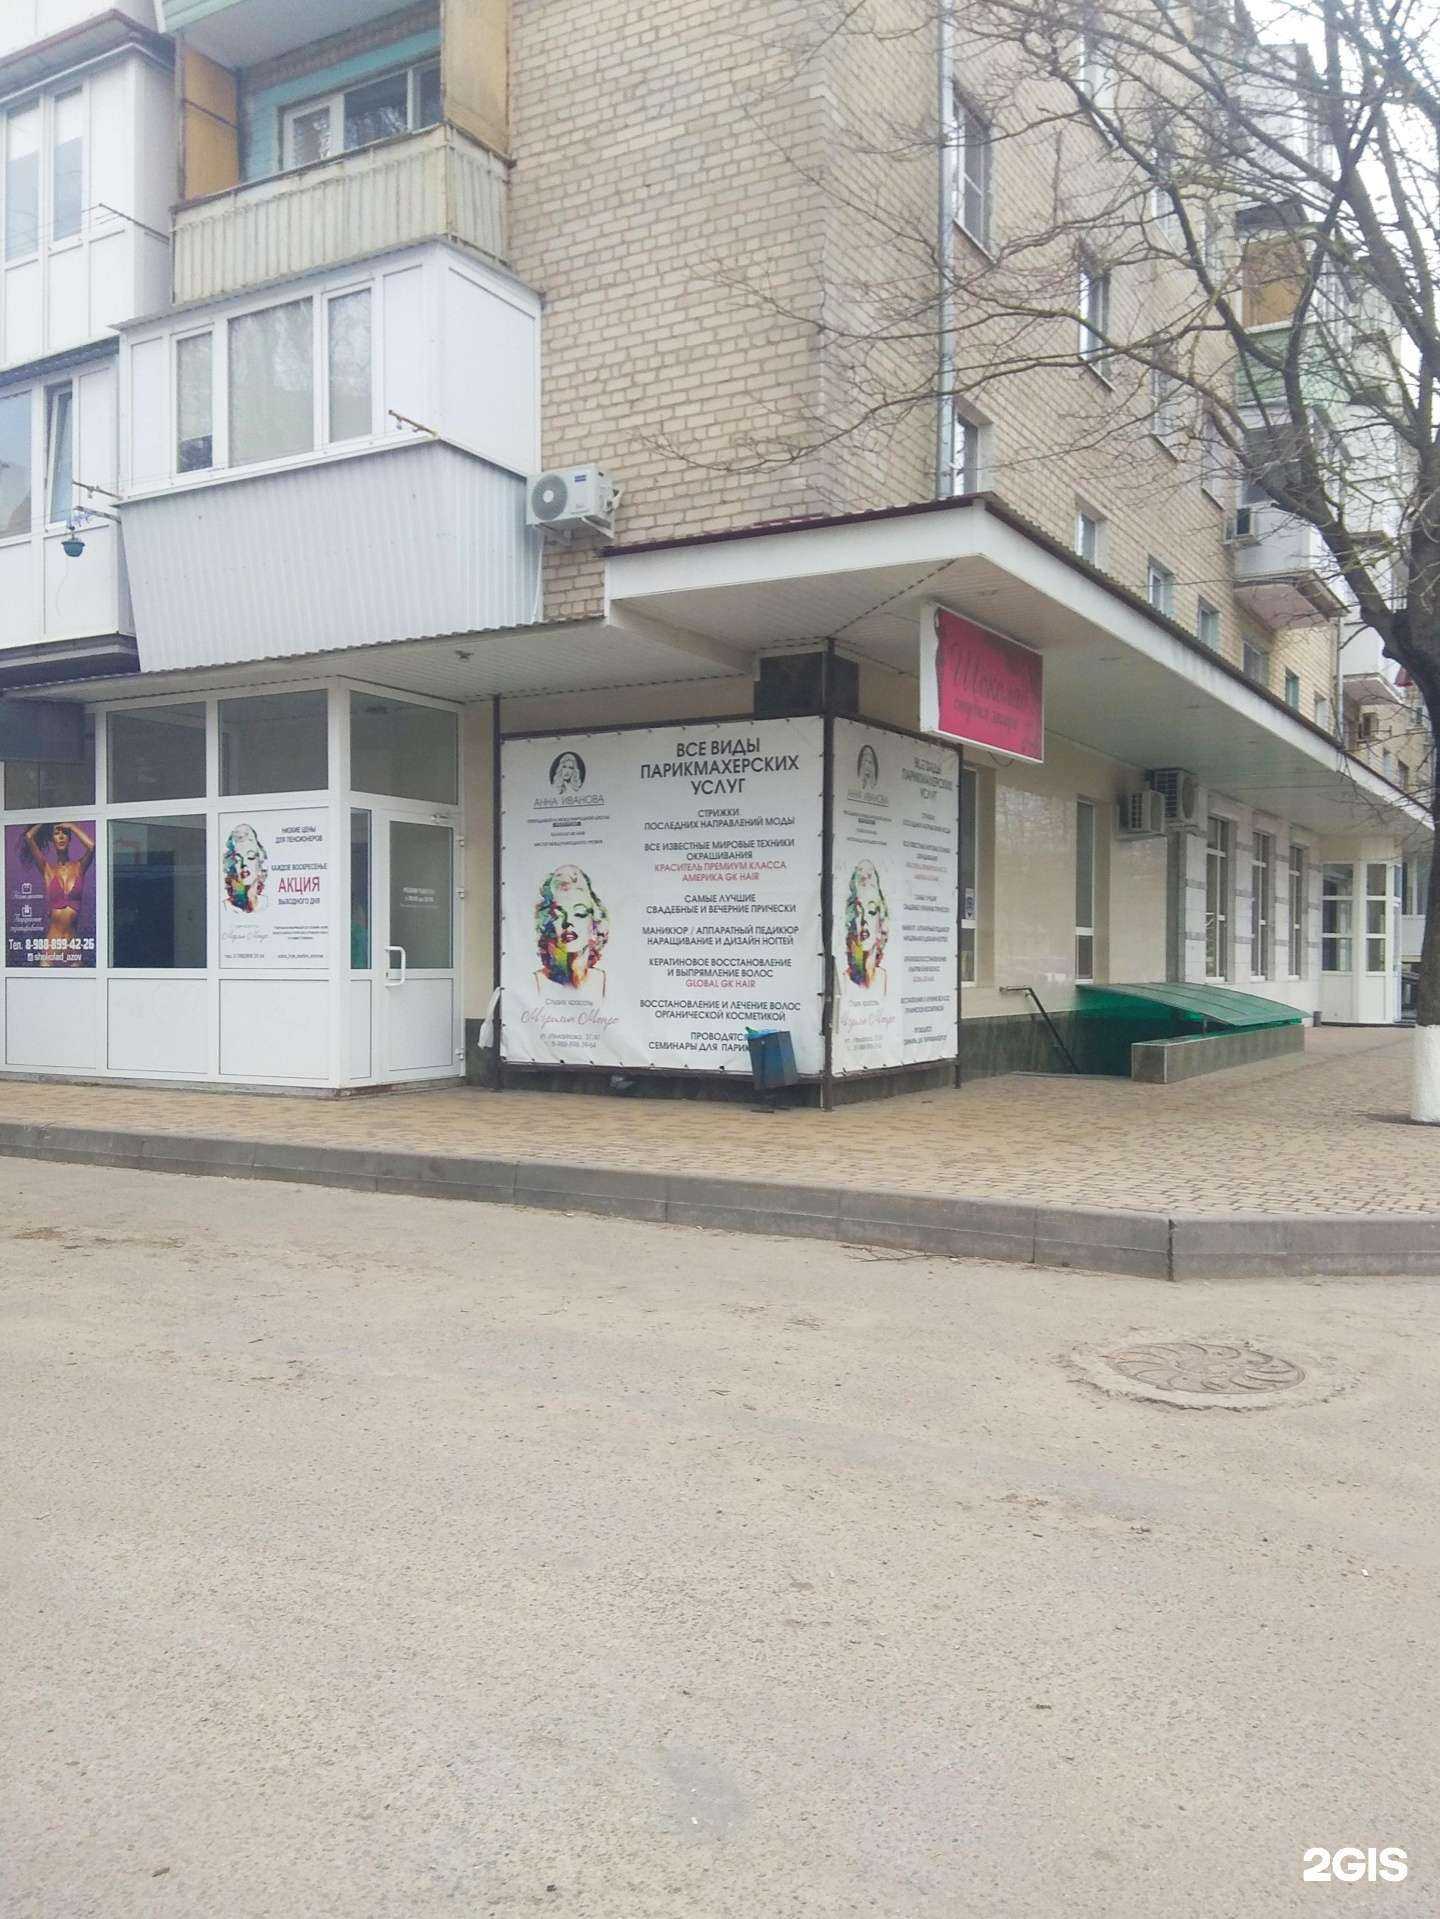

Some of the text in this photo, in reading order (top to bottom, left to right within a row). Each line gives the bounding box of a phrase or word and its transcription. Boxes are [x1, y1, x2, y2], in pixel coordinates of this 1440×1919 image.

[676, 737, 760, 757] ВСЕ ВИДЫ
[641, 755, 799, 779] ПАРИКМАХЕРСКИХ
[691, 778, 746, 795] УСЛУГ
[698, 808, 740, 818] СТРИЖКИ
[644, 816, 795, 831] ПОСЛЕДНИХ НАПРАВЛЕНИЙ МОДЫ
[644, 838, 795, 852] ВСЕ ИЗВЕСТНЫЕ МИРОВЫЕ ТЕХНИКИ
[686, 851, 753, 860] ОКРАШИВАНИЯ
[750, 860, 787, 870] КЛАССА
[682, 873, 724, 882] АМЕРИКА
[278, 876, 320, 894] АКЦИЯ
[684, 894, 756, 903] САМЫЕ ЛУЧШИЕ
[646, 904, 797, 914] СВАДЕБНЫЕ И ВЕЧЕРНИЕ ПРИЧЕСКИ
[642, 926, 688, 934] МАНИКЮР
[695, 924, 753, 934] АППАРАТНЫЙ
[755, 926, 799, 935] ПЕДИКЮР
[647, 935, 794, 946] НАРАЩИВАНИЕ И ДИЗАЙН НОГТЕЙ
[649, 958, 792, 967] КЕРАТИНОВОЕ ВОССТАНОВЛЕНИЕ
[676, 969, 740, 977] ВЫПРЯМЛЕНИЕ
[741, 969, 774, 978] ВОЛОС
[686, 980, 756, 988] GLOBAL GK HAIR
[640, 1000, 801, 1011] ВОССТАНОВЛЕНИЕ И ЛЕЧЕНИЕ ВОЛОС
[655, 1010, 786, 1021] ОРГАНИЧЕСКОЙ КОСМЕТИКОЙ
[691, 1032, 746, 1042] ПРОВОДЯТС
[648, 1042, 698, 1051] СЕМИНАРЫ
[699, 1043, 718, 1052] ДЛЯ
